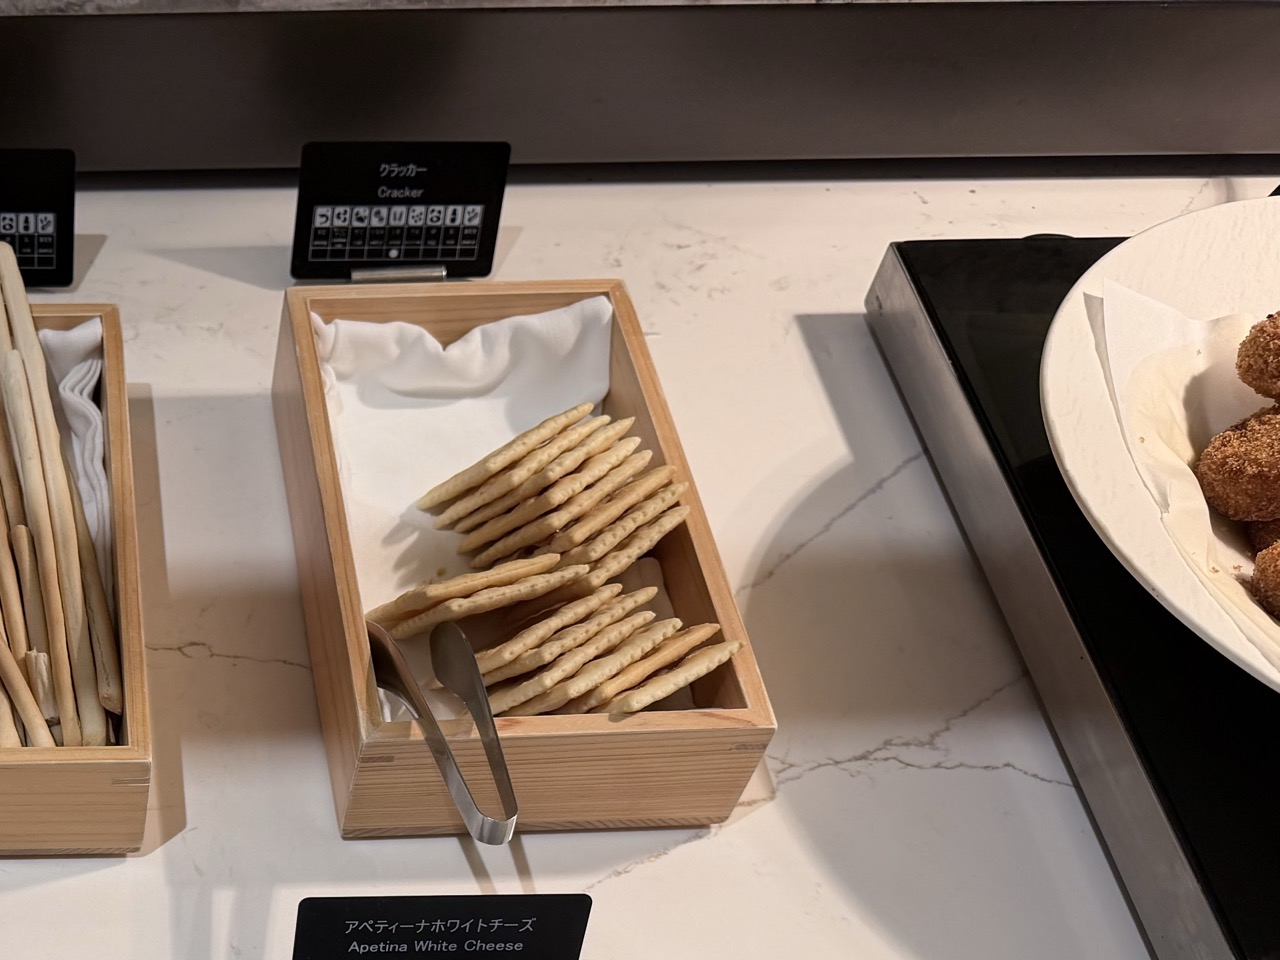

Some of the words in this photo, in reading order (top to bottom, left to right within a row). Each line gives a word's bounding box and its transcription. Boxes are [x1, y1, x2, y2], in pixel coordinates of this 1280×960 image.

[379, 163, 428, 178] クラッカー
[377, 186, 424, 199] Cracker
[344, 917, 537, 934] アペティーナホワイトチーズ
[347, 940, 408, 955] Apetina
[414, 939, 458, 952] White
[464, 938, 524, 952] Cheese
